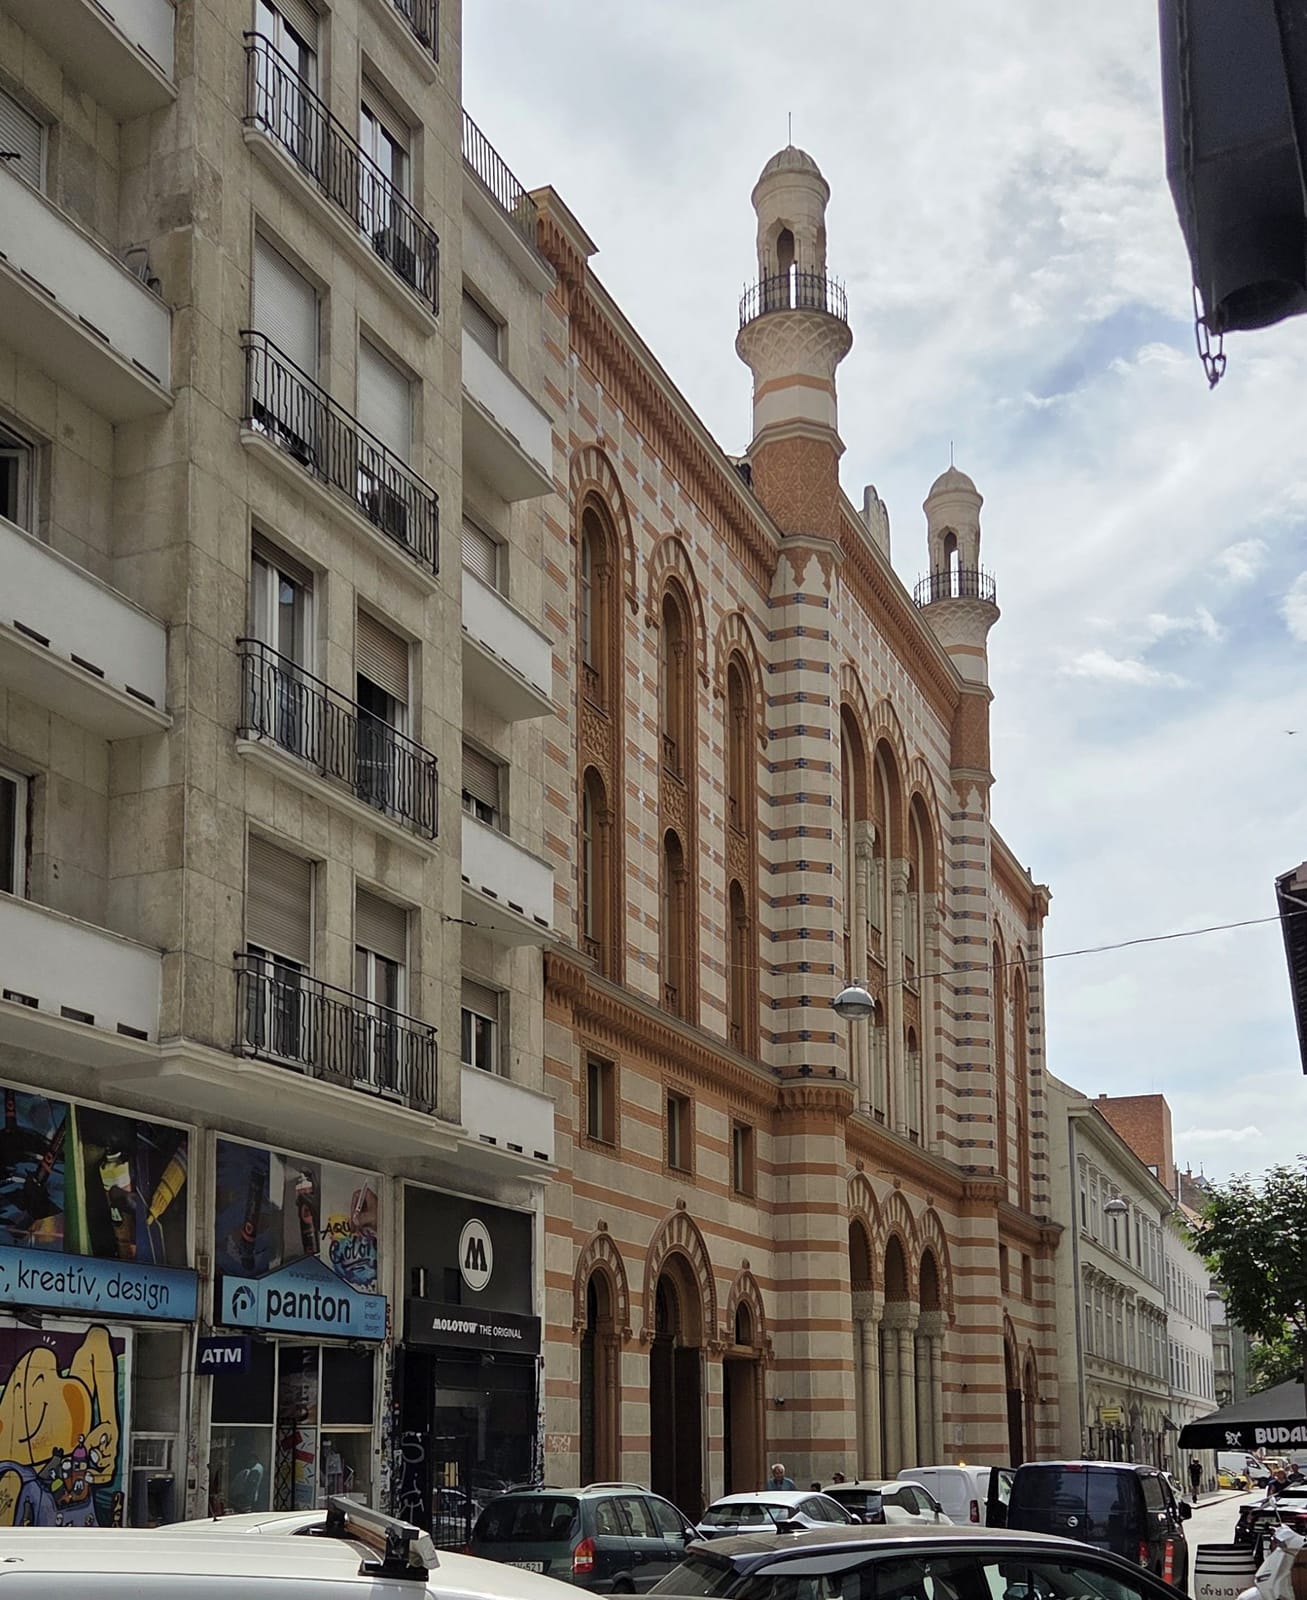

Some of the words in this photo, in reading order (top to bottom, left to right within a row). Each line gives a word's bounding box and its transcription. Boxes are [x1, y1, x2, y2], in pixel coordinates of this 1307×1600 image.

[464, 1236, 488, 1272] M
[18, 1259, 100, 1302] kreatív,
[106, 1272, 170, 1310] design
[266, 1286, 350, 1324] panton
[432, 1318, 478, 1334] MOLOTOW
[479, 1324, 492, 1336] THE
[492, 1326, 523, 1340] ORIGINAL
[201, 1347, 242, 1364] ATM
